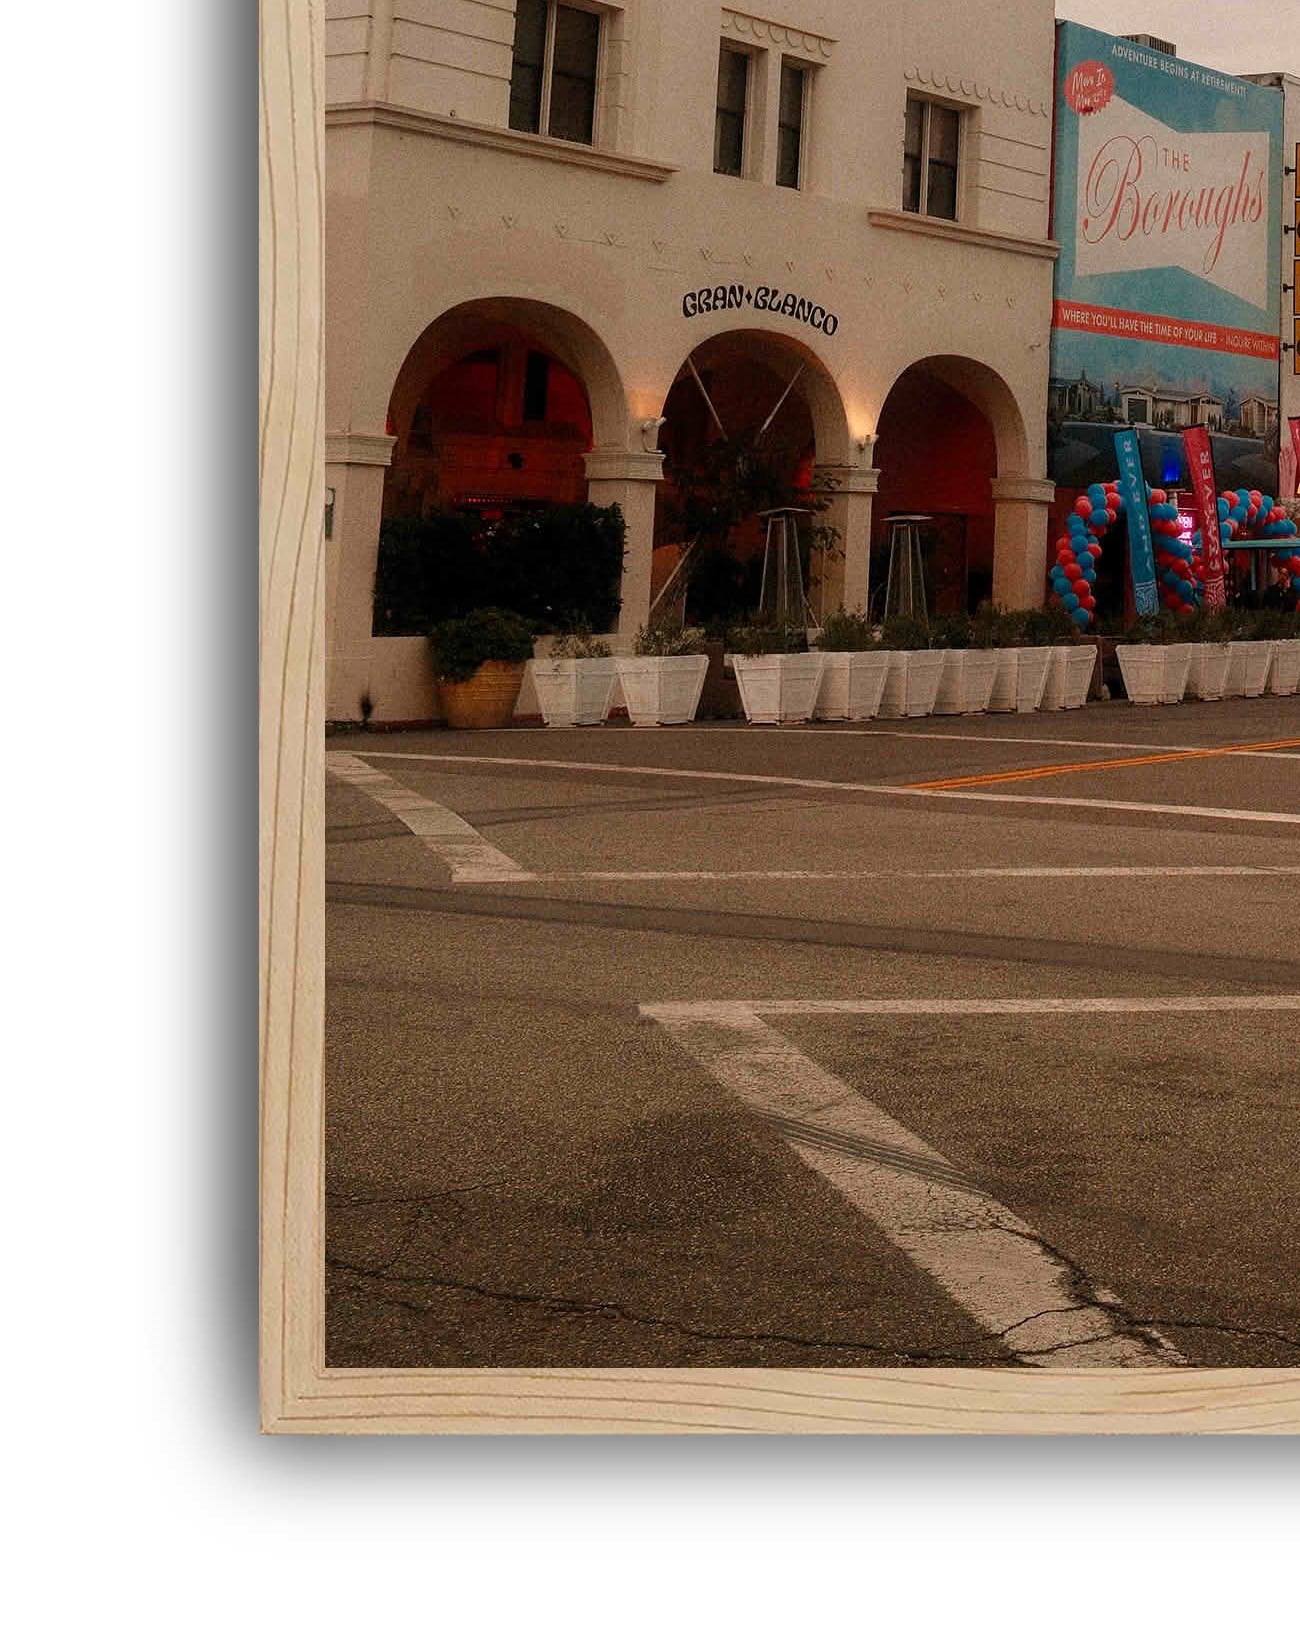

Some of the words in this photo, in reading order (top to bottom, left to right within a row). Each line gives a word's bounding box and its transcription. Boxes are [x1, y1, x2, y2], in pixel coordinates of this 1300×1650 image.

[1111, 45, 1159, 69] ADVENTURE
[1160, 60, 1189, 79] BEGINS
[1190, 70, 1201, 84] AT
[1162, 148, 1189, 172] THE
[1082, 135, 1264, 275] Boroughs
[682, 284, 745, 318] GRAN
[753, 286, 839, 336] BLANCO
[1062, 309, 1090, 325] WHERE
[1091, 312, 1118, 328] YOU'LL
[1119, 317, 1138, 332] HAVE
[1139, 321, 1153, 334] THE
[1154, 323, 1172, 336] TIME
[1173, 326, 1183, 339] OF
[1183, 328, 1204, 342] YOUR
[1204, 332, 1217, 344] LIFE
